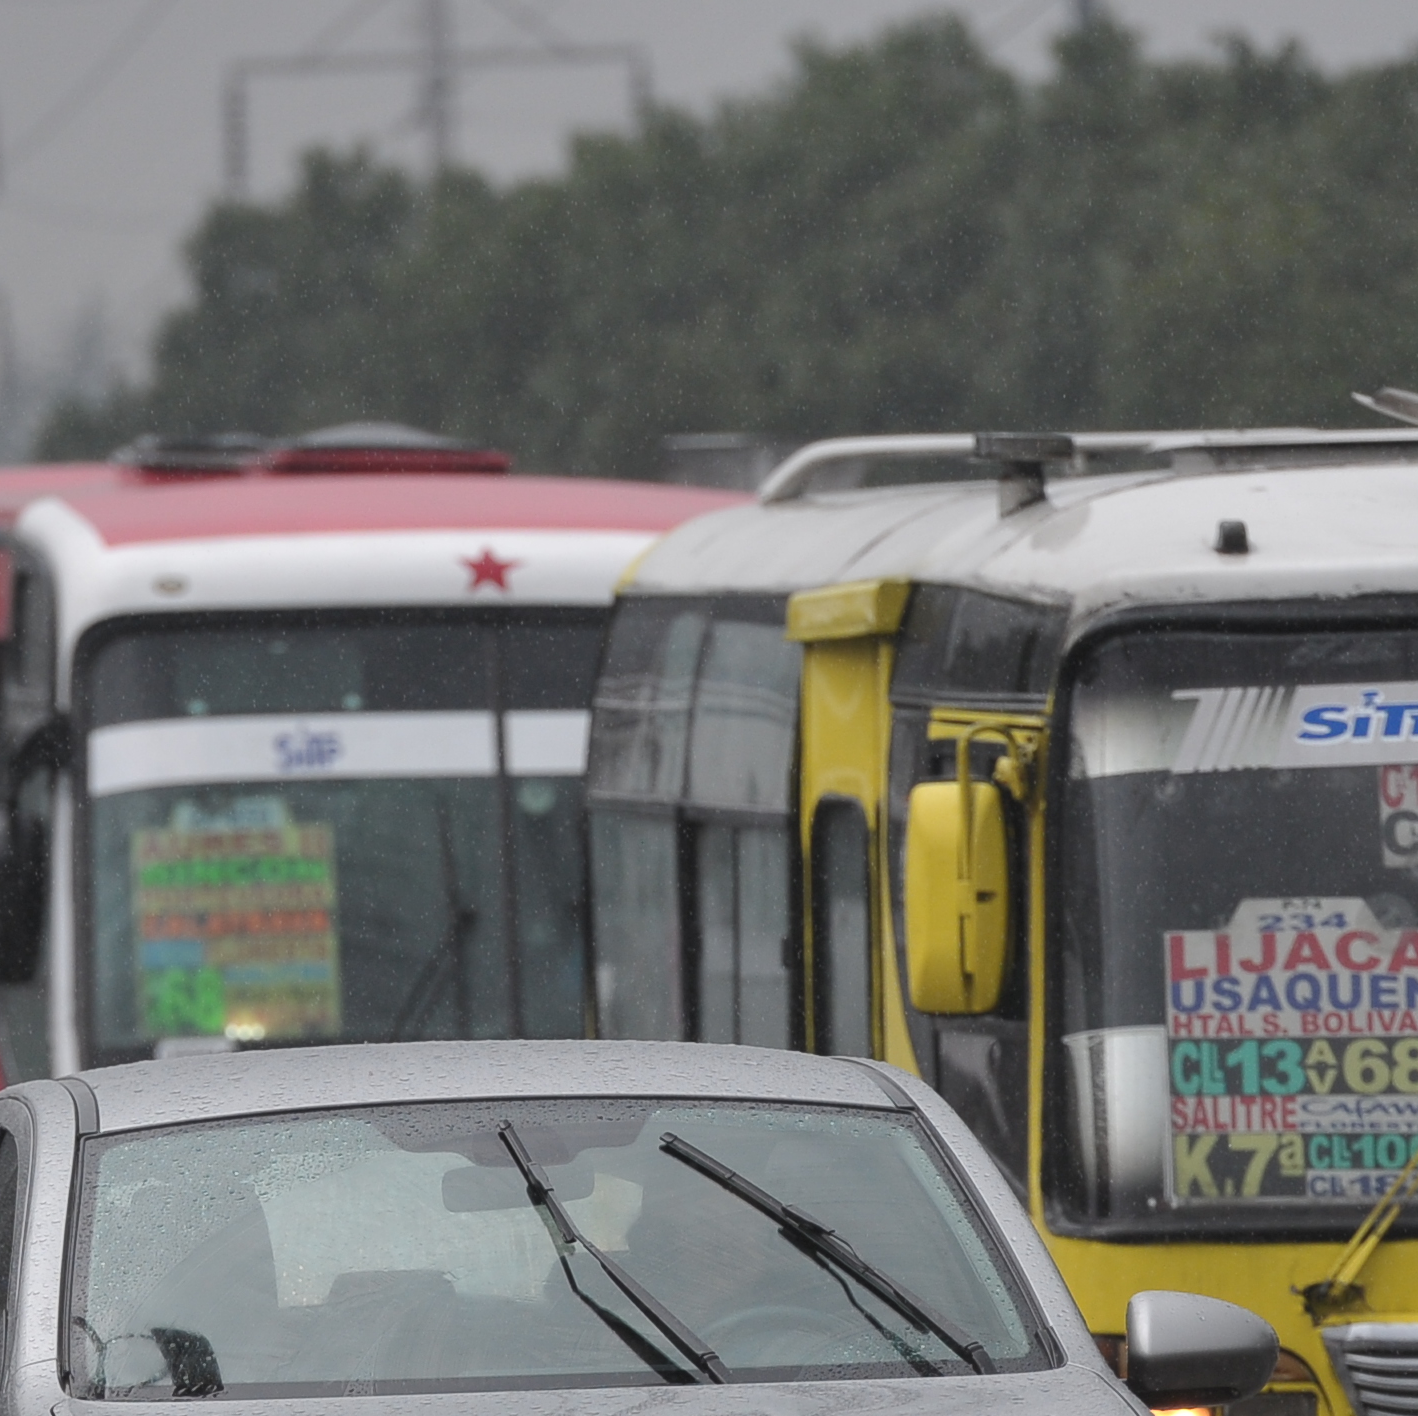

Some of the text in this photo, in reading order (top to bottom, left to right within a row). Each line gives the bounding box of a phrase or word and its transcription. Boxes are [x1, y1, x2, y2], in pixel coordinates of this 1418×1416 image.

[1257, 913, 1348, 931] 234
[1172, 1014, 1253, 1036] HTAL
[1262, 1013, 1289, 1035] S.
[1171, 1095, 1297, 1132] SALITRE
